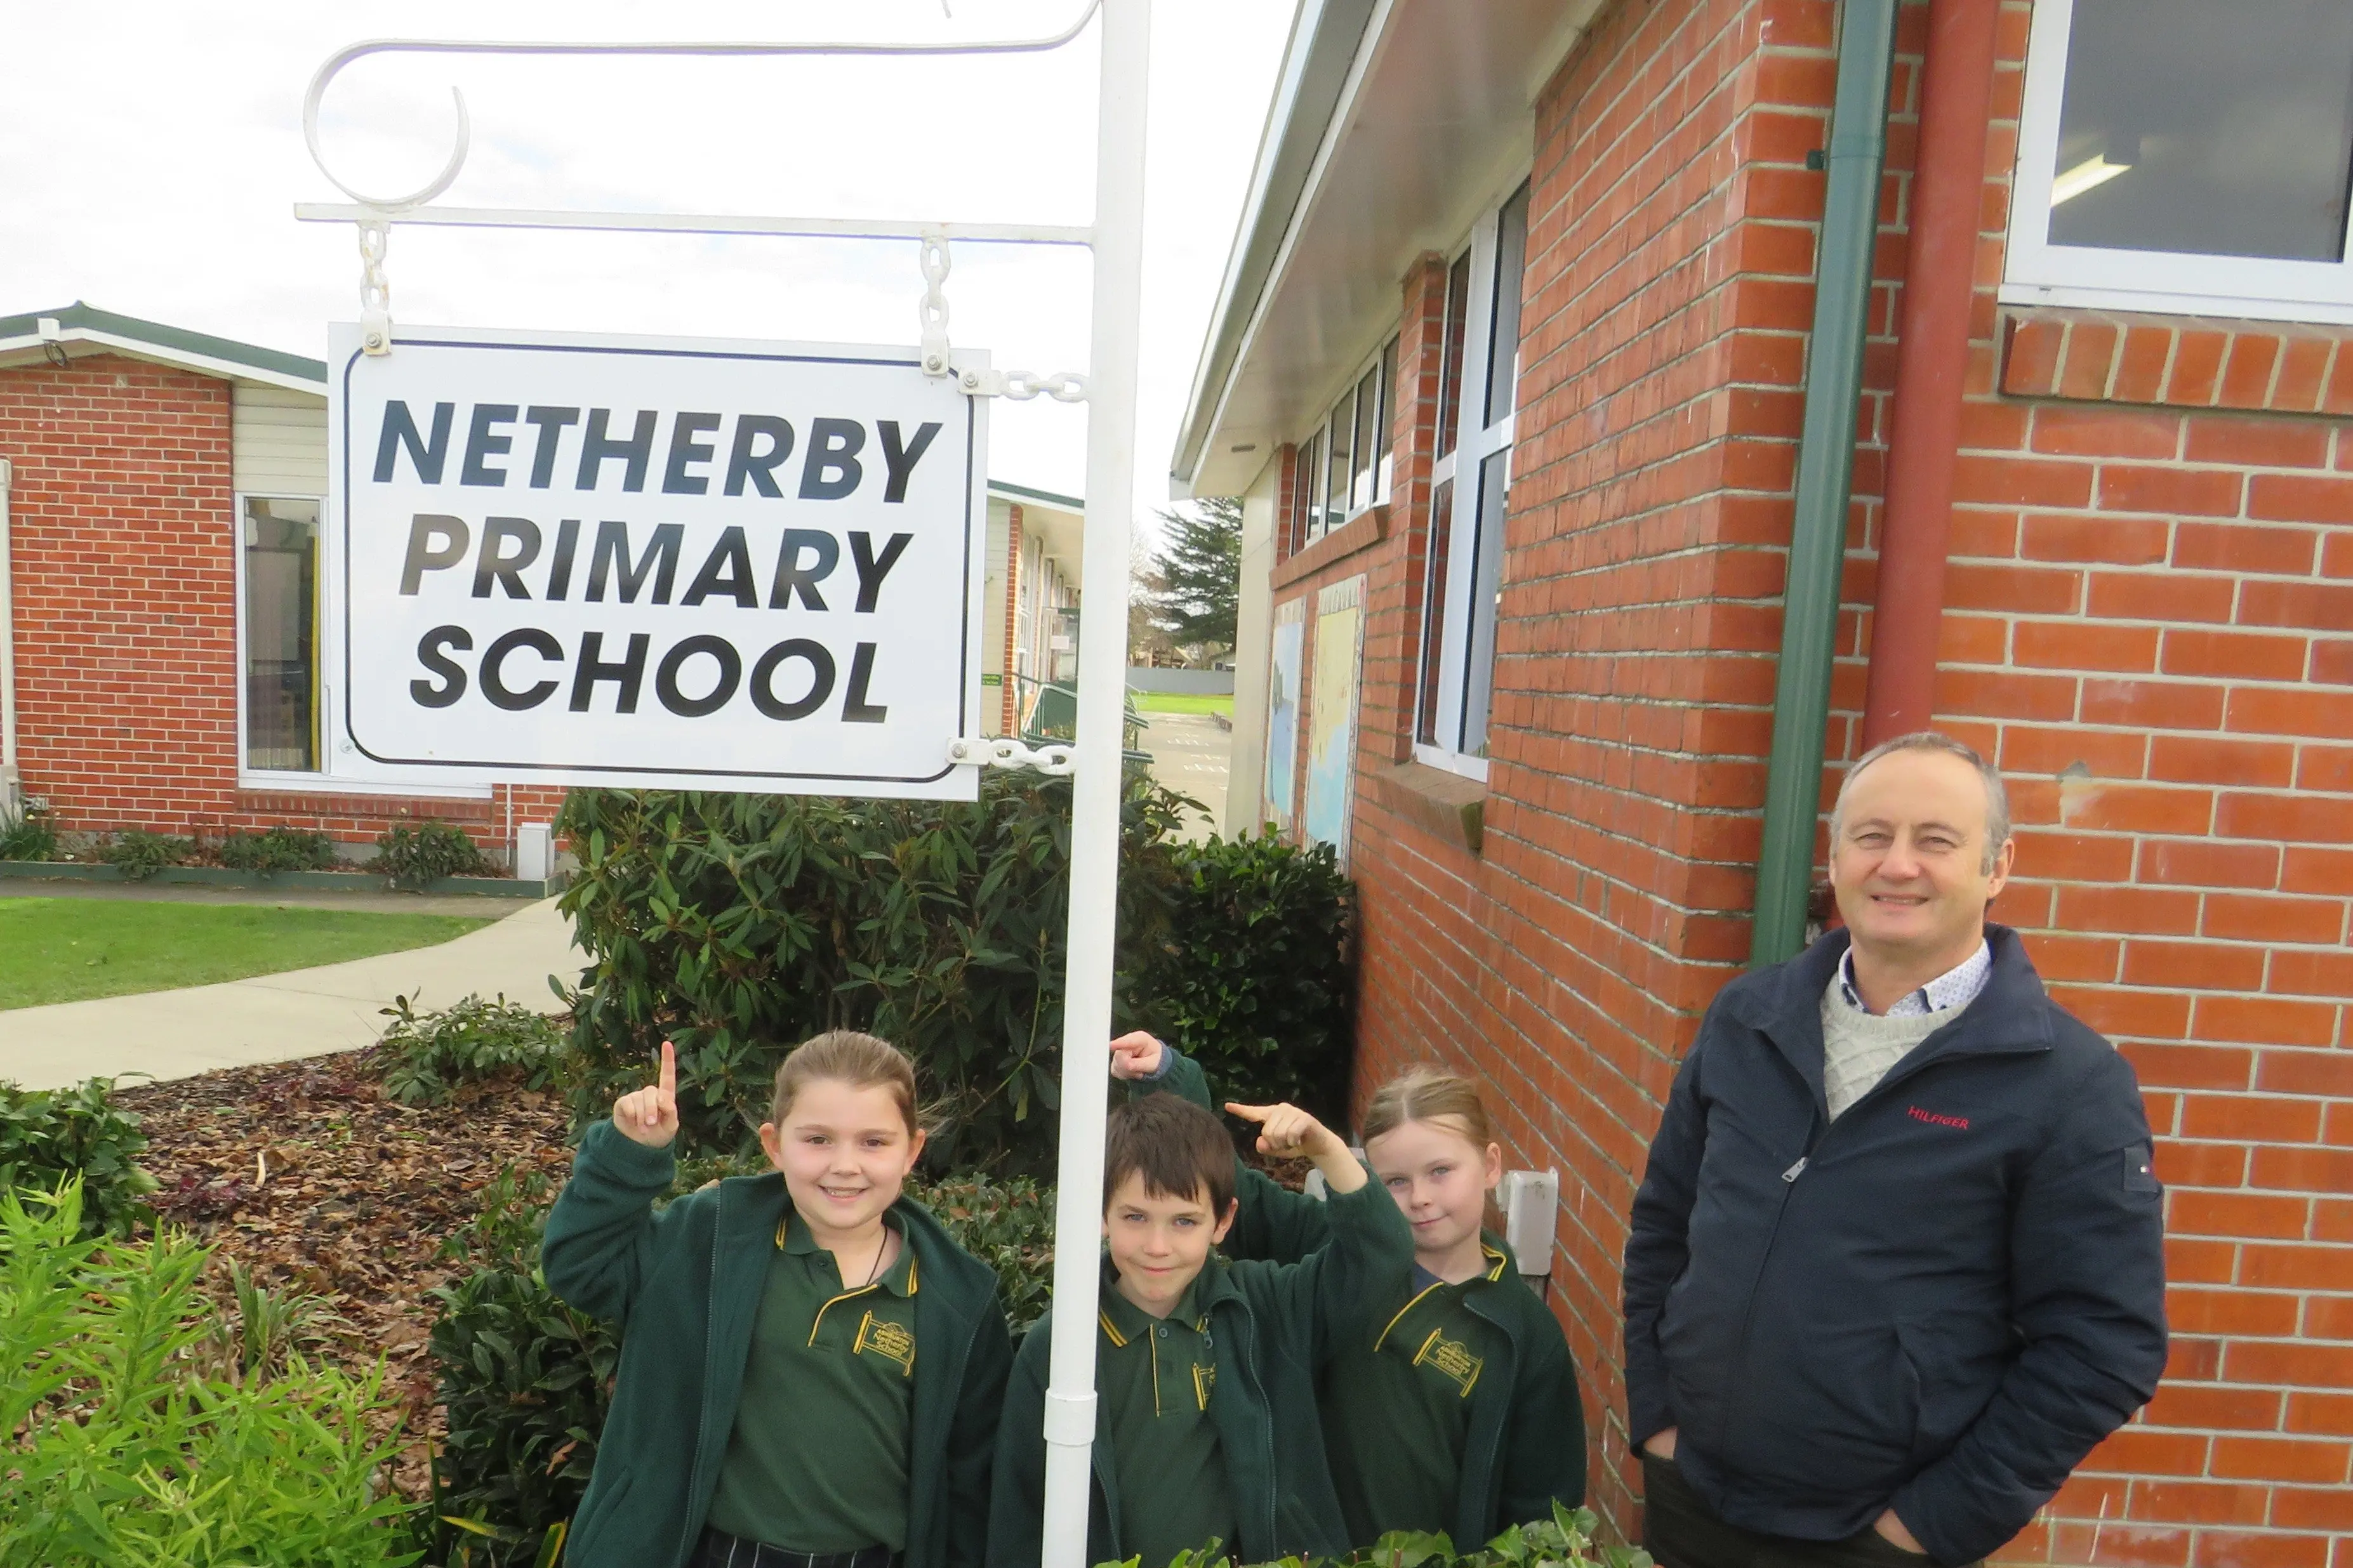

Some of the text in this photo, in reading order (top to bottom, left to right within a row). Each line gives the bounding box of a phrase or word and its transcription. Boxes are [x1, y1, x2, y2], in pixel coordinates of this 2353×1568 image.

[373, 400, 943, 504] NETHERBY
[399, 514, 915, 614] PRIMARY
[409, 624, 888, 723] SCHOOL
[1908, 1105, 1969, 1130] HILFIGER
